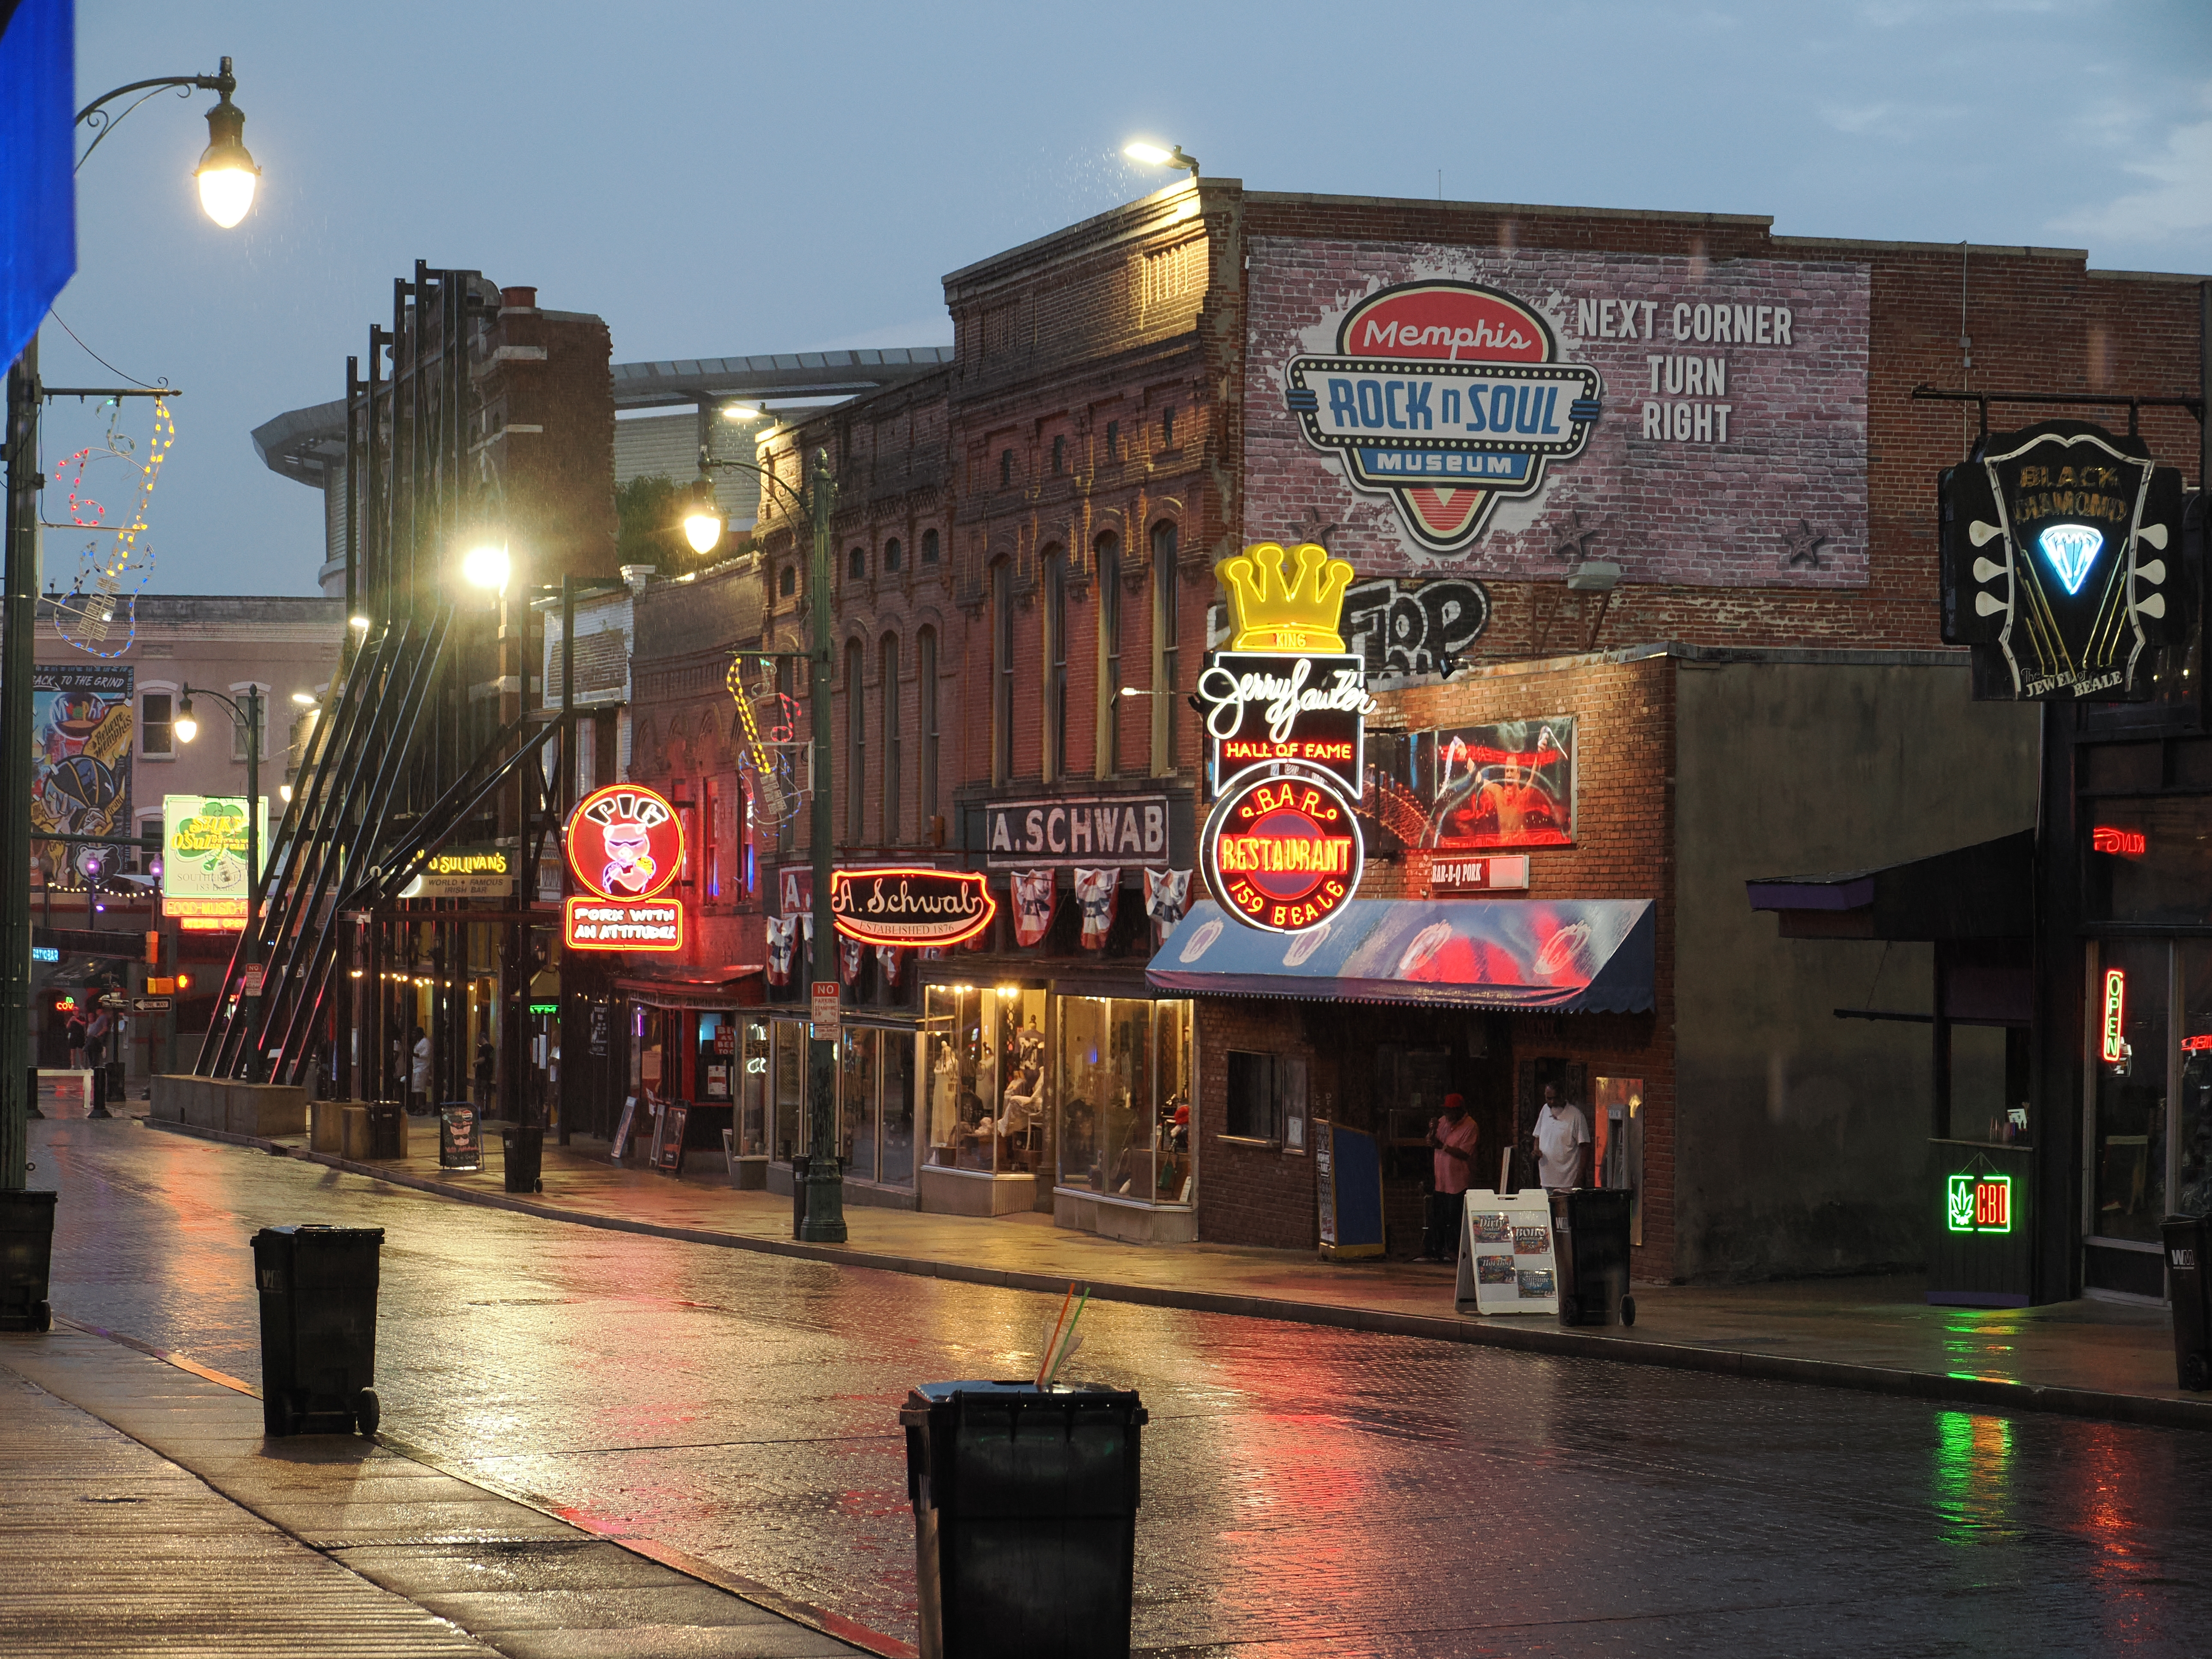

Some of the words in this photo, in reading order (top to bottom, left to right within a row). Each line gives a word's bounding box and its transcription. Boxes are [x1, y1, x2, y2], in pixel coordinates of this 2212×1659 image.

[1579, 299, 1657, 338] NEXT
[1674, 303, 1791, 345] CORNER
[1364, 319, 1531, 360] Memphis
[1647, 356, 1725, 396] TURN
[1328, 378, 1432, 430] ROCK
[1442, 389, 1460, 423] n
[1466, 384, 1560, 434] SOUL
[1644, 402, 1731, 442] RIGHT
[2020, 466, 2118, 488] BLACK
[2014, 491, 2127, 524] DIAMOND
[1276, 633, 1306, 647] KING
[61, 676, 72, 685] TO
[75, 676, 93, 686] THE
[94, 676, 124, 688] GRIND
[2021, 668, 2040, 682] The
[2026, 670, 2078, 697] JEWEL
[2072, 671, 2122, 697] BEALE
[2077, 670, 2087, 682] of
[1198, 667, 1291, 739] Jerry
[1269, 658, 1377, 743] Lawler
[1227, 743, 1272, 757] HALL
[1276, 743, 1298, 757] OF
[1306, 744, 1351, 759] FAME
[585, 794, 669, 828] PIG
[1257, 784, 1320, 815] BAR
[189, 815, 244, 834] SILKY
[1222, 839, 1351, 871] RESTAURANT
[178, 873, 233, 882] SOUTHER
[1432, 864, 1461, 887] BAR-B-Q
[1462, 863, 1482, 882] PORK
[832, 879, 863, 912] A.
[868, 878, 984, 913] Schwab
[1231, 882, 1263, 912] 159
[1273, 881, 1344, 926] BEALE
[183, 918, 218, 928] KITCHEN
[222, 919, 246, 928] OPEN
[574, 908, 625, 922] PORK
[629, 908, 675, 922] WITH
[574, 924, 597, 939] AN
[599, 924, 676, 940] ATTITUDE
[859, 922, 930, 934] ESTABLISHED
[933, 923, 955, 934] 1876
[818, 985, 834, 994] NO
[2107, 976, 2121, 1056] OPEN
[1977, 1185, 2008, 1223] CBD
[1479, 1217, 1505, 1228] Dirty
[1516, 1228, 1546, 1237] BOHO
[2171, 1249, 2194, 1265] WM
